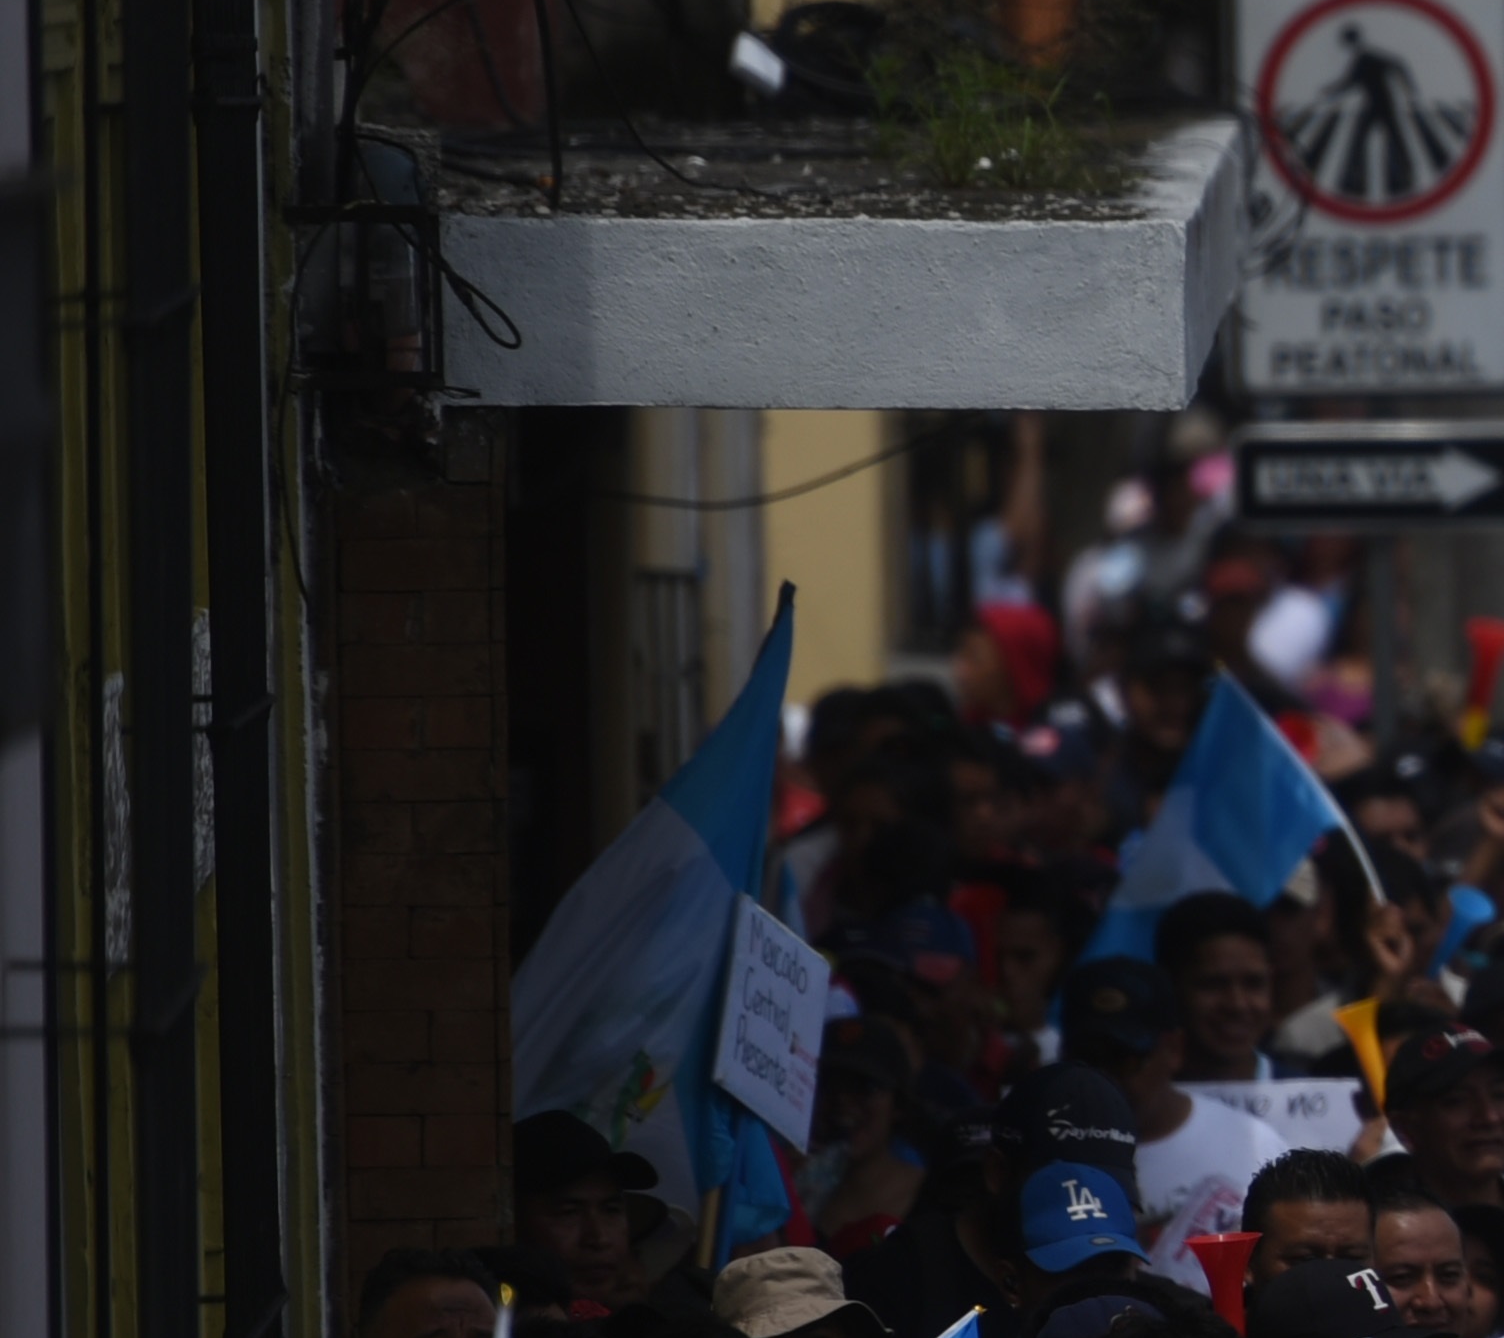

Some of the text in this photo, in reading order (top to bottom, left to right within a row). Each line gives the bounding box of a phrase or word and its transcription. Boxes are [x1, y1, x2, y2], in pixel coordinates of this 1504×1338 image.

[1263, 234, 1488, 289] RESPETE
[1320, 297, 1432, 331] PASO
[1270, 342, 1478, 379] PEATONAL
[1061, 1179, 1108, 1221] LA
[1346, 1267, 1390, 1311] T
